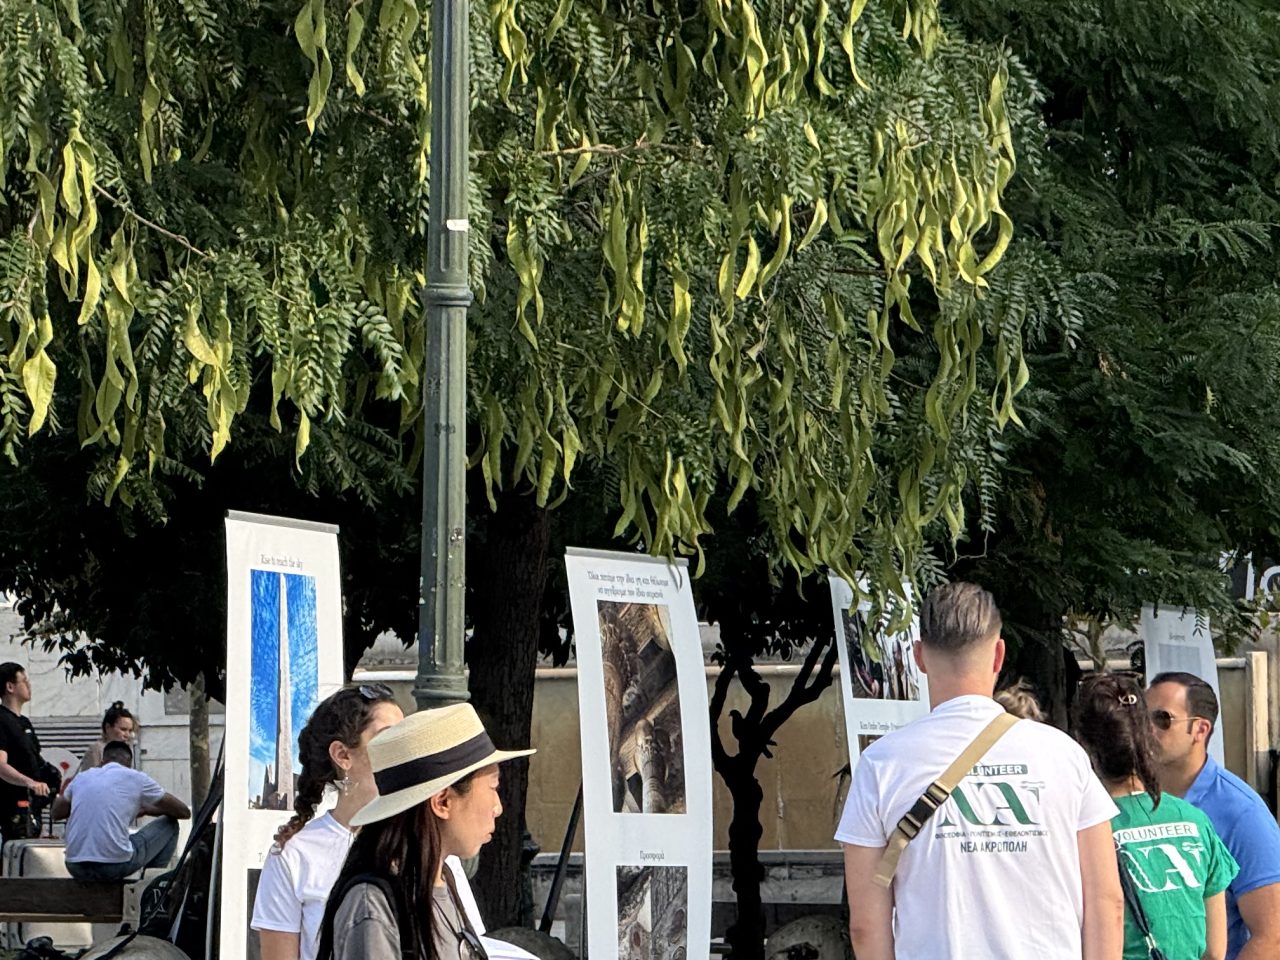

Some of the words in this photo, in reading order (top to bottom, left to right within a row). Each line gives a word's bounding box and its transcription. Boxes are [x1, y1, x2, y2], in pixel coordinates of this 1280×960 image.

[967, 765, 1023, 777] LUNTEER
[1113, 825, 1193, 844] VOLUNTEER
[960, 841, 978, 853] ΝΕΑ
[980, 840, 1028, 853] ΑΚΡΟΠΟΛΗ
